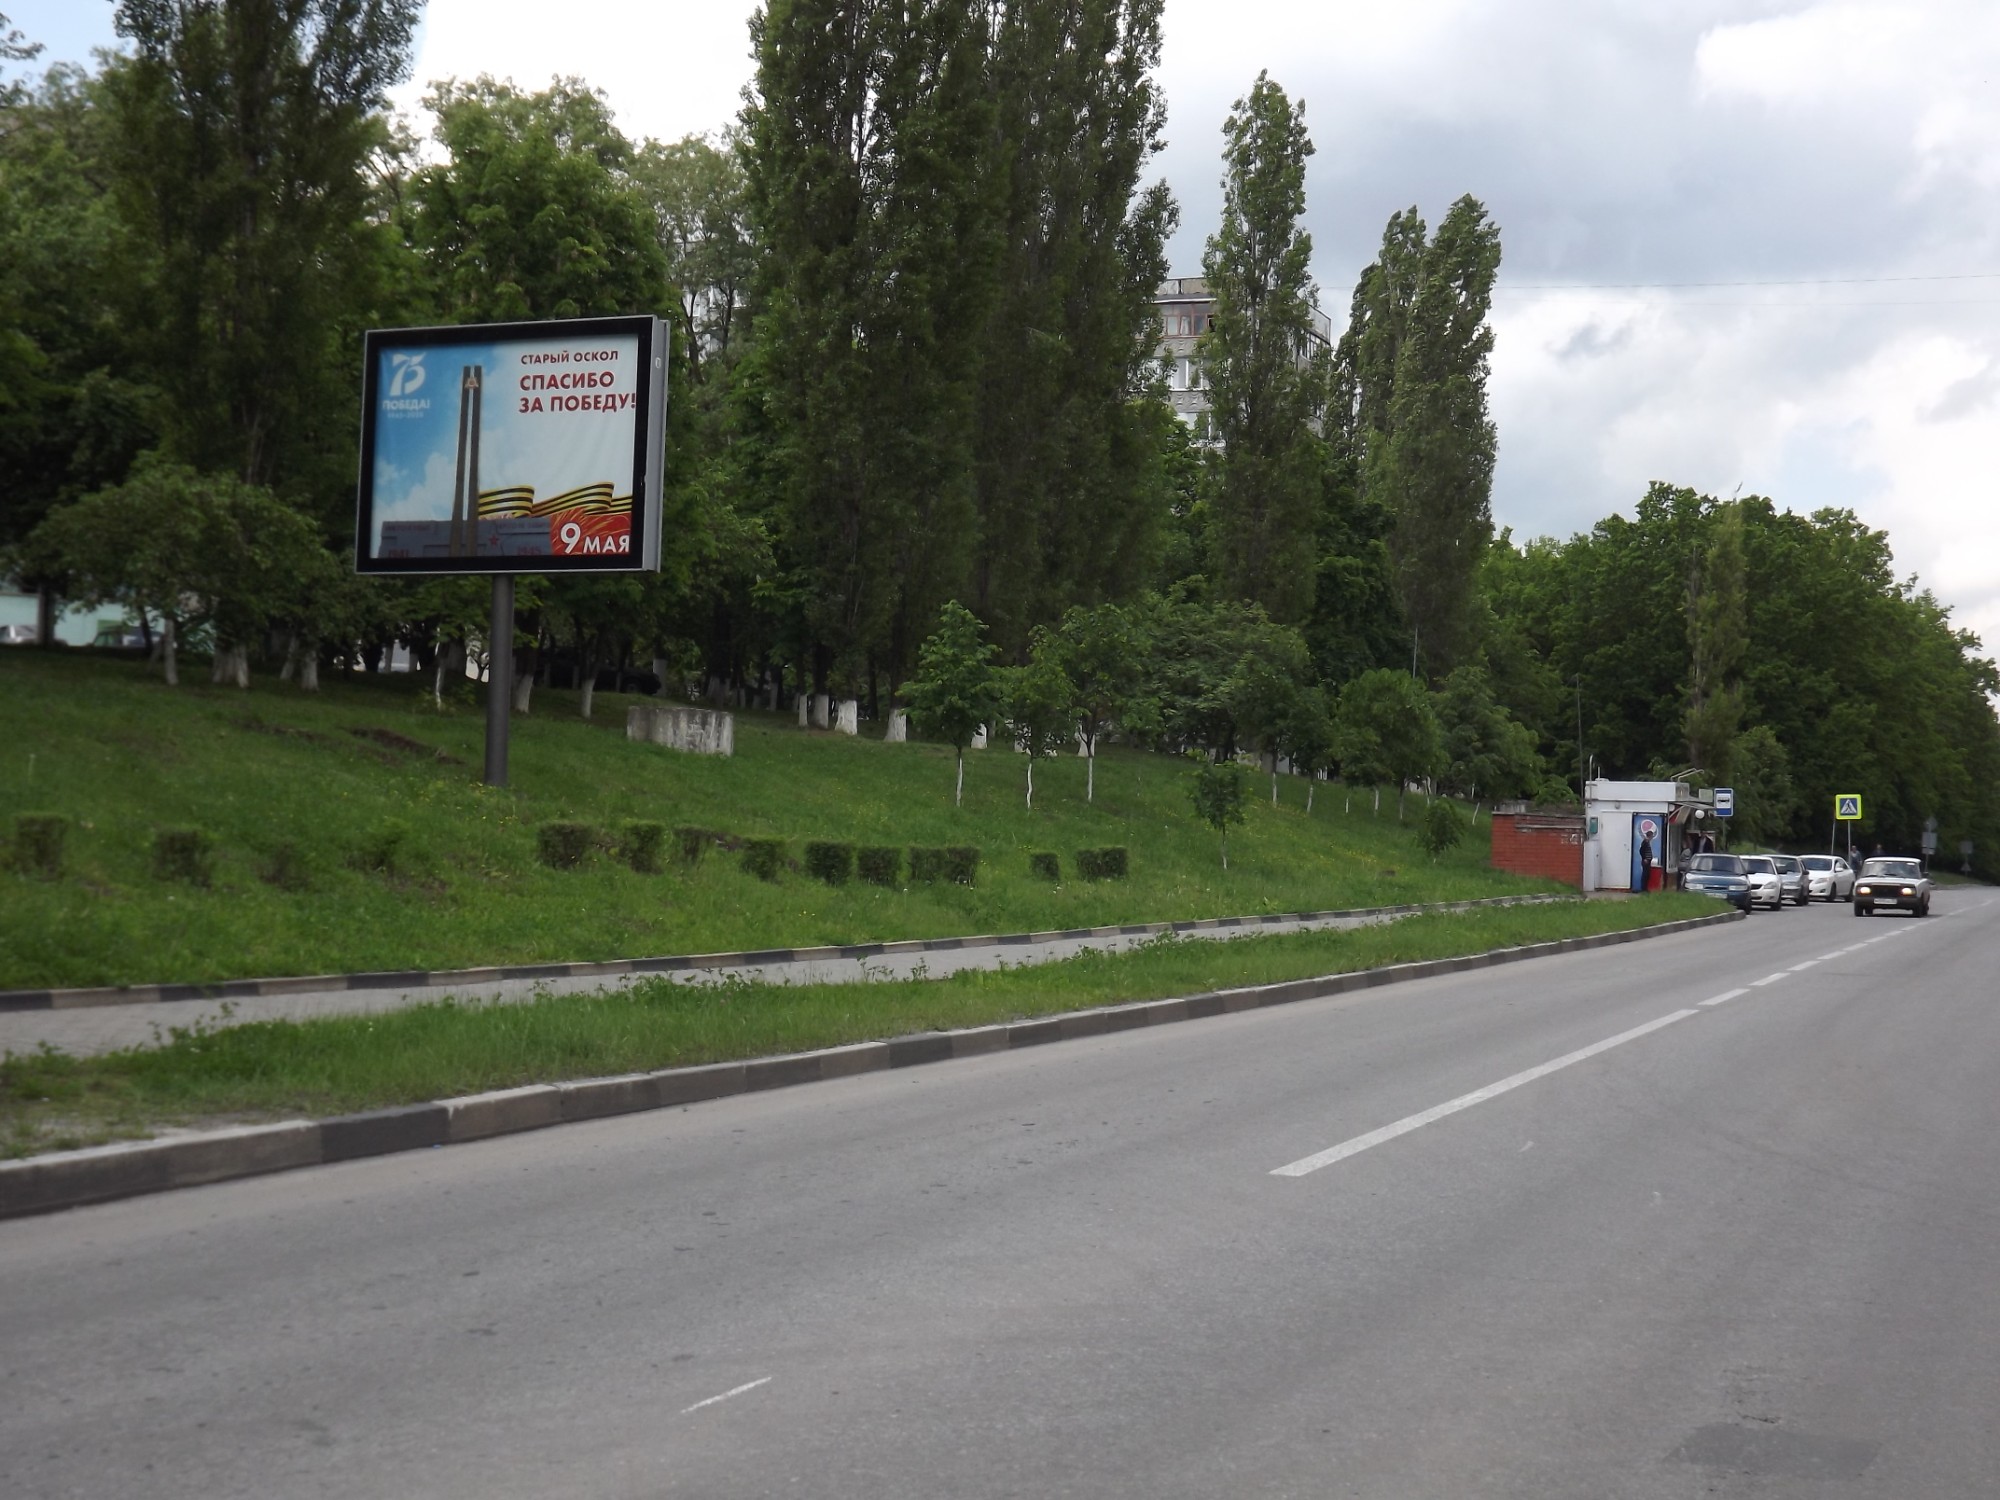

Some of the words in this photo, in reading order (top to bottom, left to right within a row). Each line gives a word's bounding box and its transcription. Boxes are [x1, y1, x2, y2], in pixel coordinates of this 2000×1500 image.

[521, 350, 569, 365] СТАРЫЙ
[573, 350, 619, 362] ОСКОЛ
[389, 351, 427, 396] 75
[520, 371, 615, 391] СПАСИБО
[382, 399, 430, 410] ПОБЕДА!
[519, 397, 543, 413] ЗА
[550, 393, 636, 412] ПОБЕДУ!
[560, 522, 581, 554] 9
[583, 535, 630, 554] МАЯ
